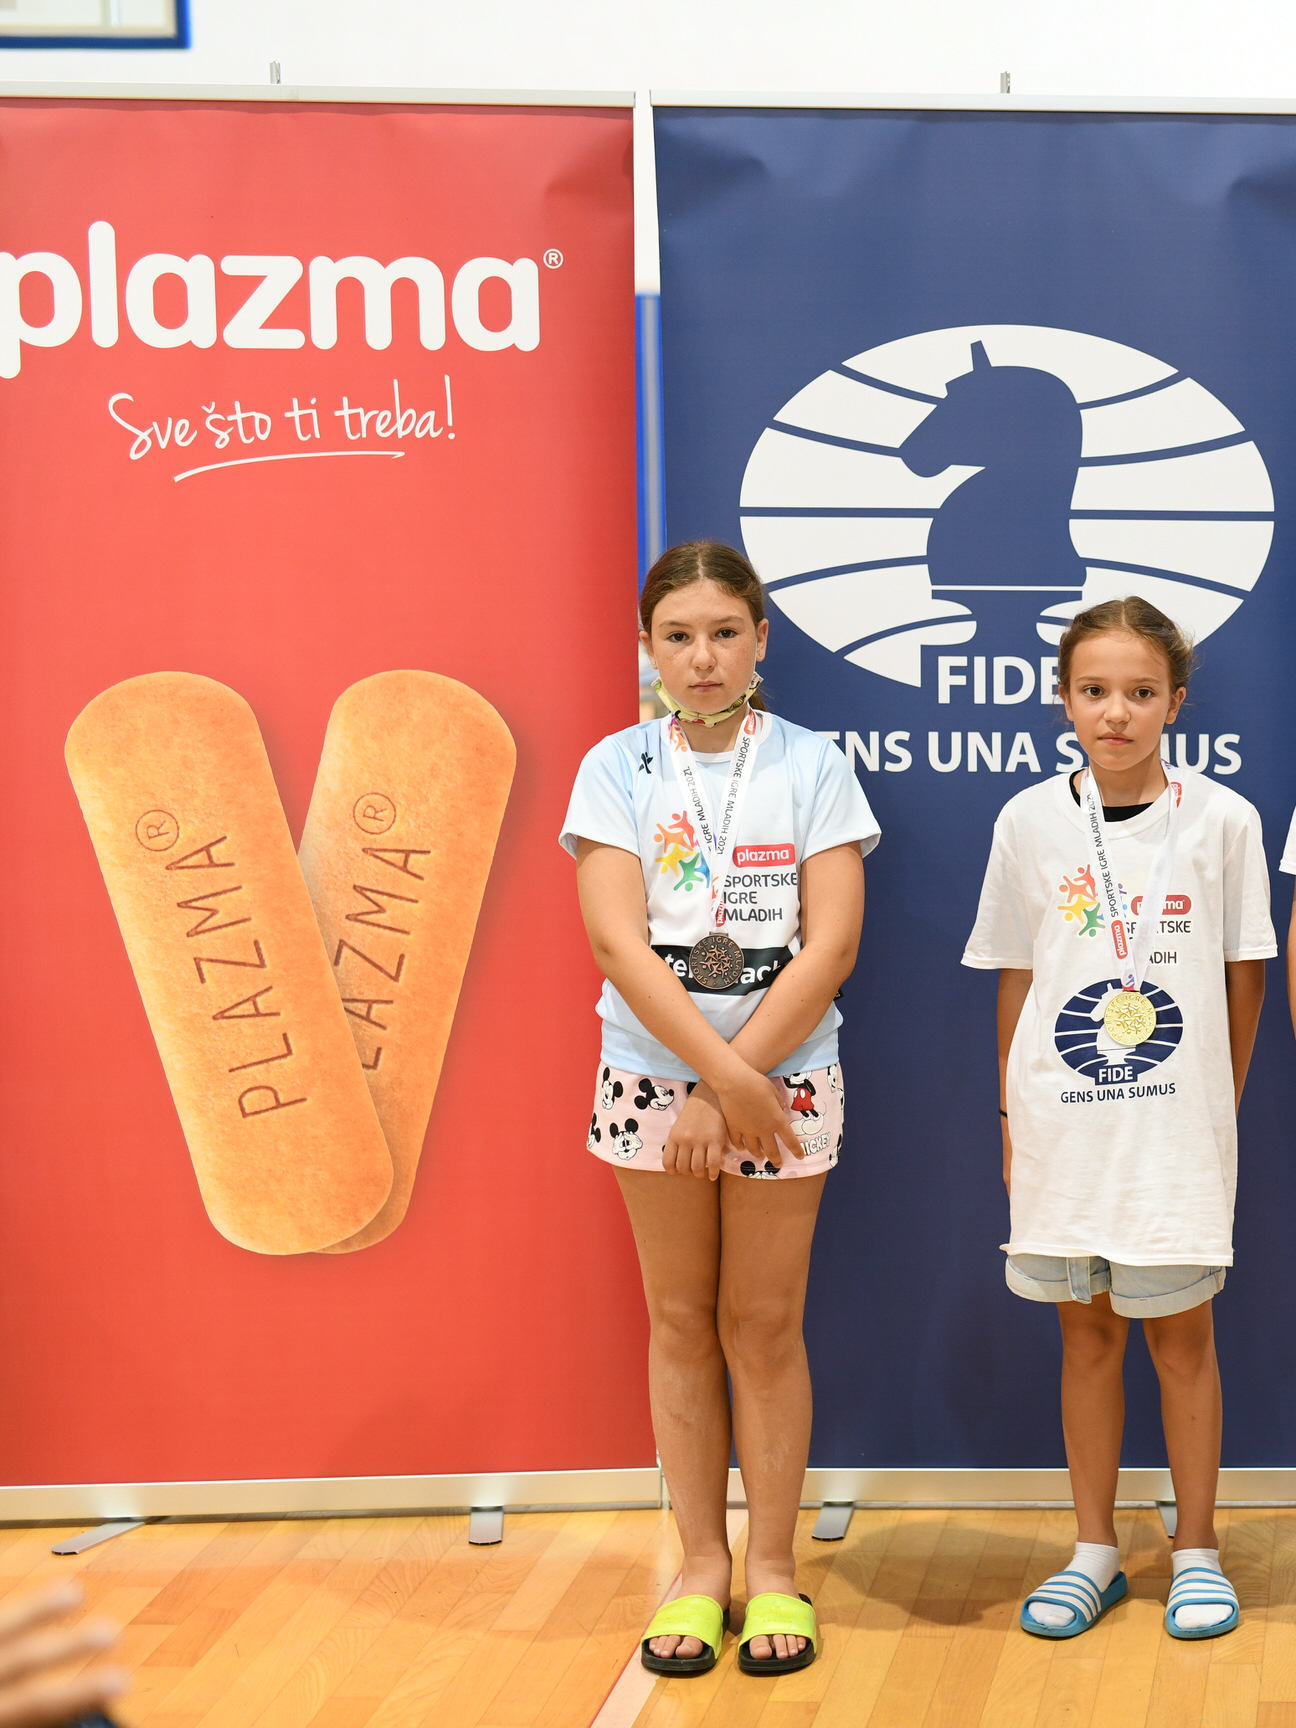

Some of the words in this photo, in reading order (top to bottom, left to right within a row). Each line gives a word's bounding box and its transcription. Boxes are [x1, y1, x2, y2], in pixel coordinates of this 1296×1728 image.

[108, 392, 197, 460] Sve
[201, 401, 271, 449] što
[284, 397, 320, 441] ti
[334, 374, 455, 440] treba!
[938, 656, 1065, 705] FIDE
[733, 736, 751, 778] SPORTSKE
[814, 730, 913, 773] NS
[928, 731, 1042, 773] UNA
[1056, 731, 1243, 775] SUS
[728, 779, 740, 799] IGRE
[691, 787, 707, 822] MLADIH
[720, 800, 735, 834] MLADIH
[700, 824, 713, 844] IGRE
[1089, 813, 1103, 848] MLADIH
[737, 848, 790, 865] plazma
[1097, 849, 1108, 870] IGRE
[724, 872, 798, 888] SPORTSKE
[724, 891, 758, 904] IGRE
[1102, 870, 1119, 918] SPORTSKE
[724, 907, 783, 922] MLADIH
[712, 936, 735, 948] IGRE
[1098, 1066, 1133, 1083] FIDE
[1060, 1090, 1094, 1103] GENS
[1097, 1088, 1125, 1102] UNA
[1128, 1082, 1176, 1099] SUMUS
